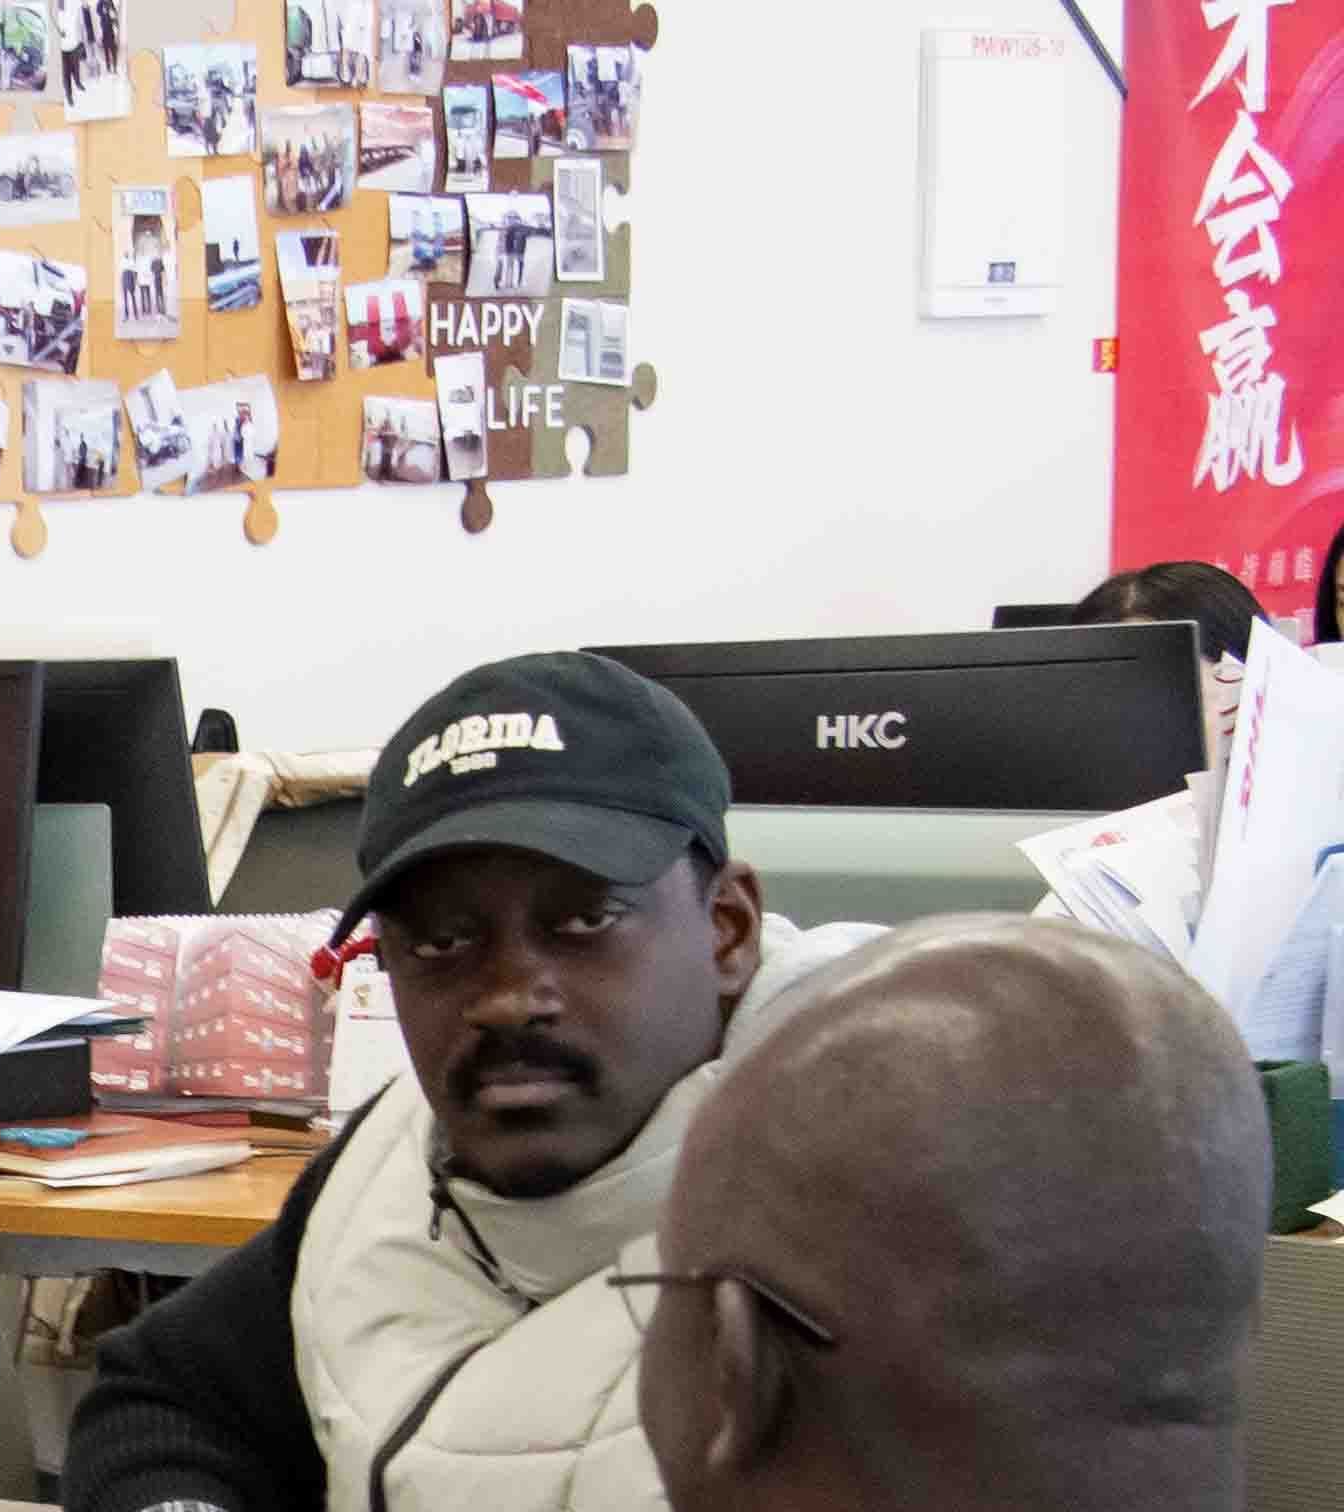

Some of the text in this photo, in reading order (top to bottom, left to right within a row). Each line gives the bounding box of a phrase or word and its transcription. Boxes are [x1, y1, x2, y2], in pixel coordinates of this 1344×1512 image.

[430, 301, 545, 347] HAPPY
[487, 384, 566, 430] LIFE
[403, 712, 566, 788] FLORIDA
[815, 711, 908, 750] HKC
